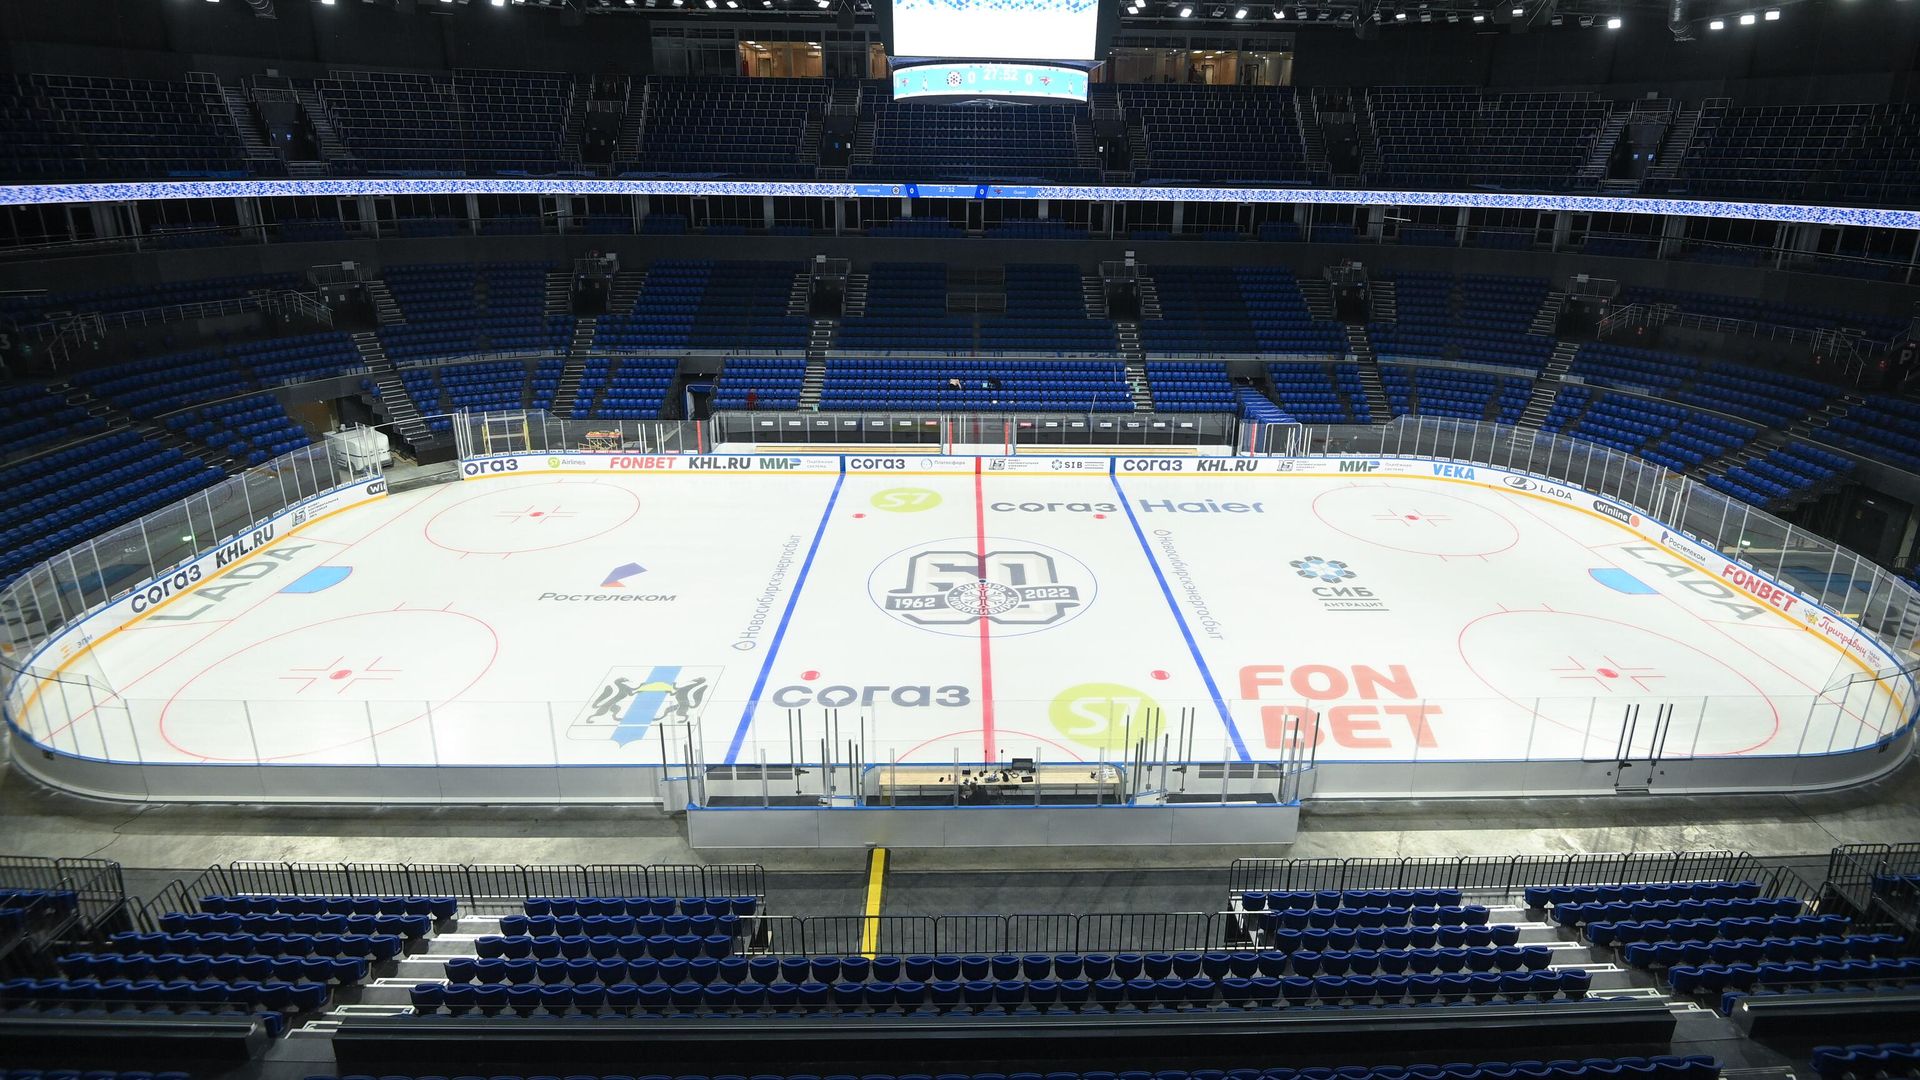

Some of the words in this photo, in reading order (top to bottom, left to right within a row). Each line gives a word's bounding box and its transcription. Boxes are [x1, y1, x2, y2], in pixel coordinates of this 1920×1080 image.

[968, 72, 976, 85] 0
[983, 66, 1019, 81] 27:52
[1025, 72, 1033, 86] 0
[610, 457, 676, 468] FONBET
[689, 457, 750, 469] KHL.RU
[760, 458, 801, 469] МИР
[1197, 460, 1258, 471] KHL.RU
[1339, 461, 1380, 472] МИР
[1433, 464, 1475, 480] VEKA
[878, 492, 932, 508] S7
[1540, 484, 1573, 501] LADA
[1139, 499, 1264, 513] Haier
[1596, 501, 1628, 523] Winline
[215, 523, 274, 569] KHL.RU
[1669, 537, 1706, 563] Ростелеком
[145, 543, 316, 621] LADA
[739, 534, 801, 639] Новосибирскэнергосбыт
[1159, 535, 1224, 641] Новосибирскэнергосбыт
[1620, 547, 1767, 621] LADA
[1722, 563, 1797, 612] FONBET
[538, 592, 676, 602] Ростелеком
[1025, 588, 1070, 599] 2022
[1312, 587, 1374, 597] СИБ
[894, 597, 936, 608] 1962
[1818, 616, 1867, 657] Приправыч
[1239, 664, 1419, 700] FON
[1068, 697, 1142, 736] S7
[1261, 705, 1443, 750] BET
